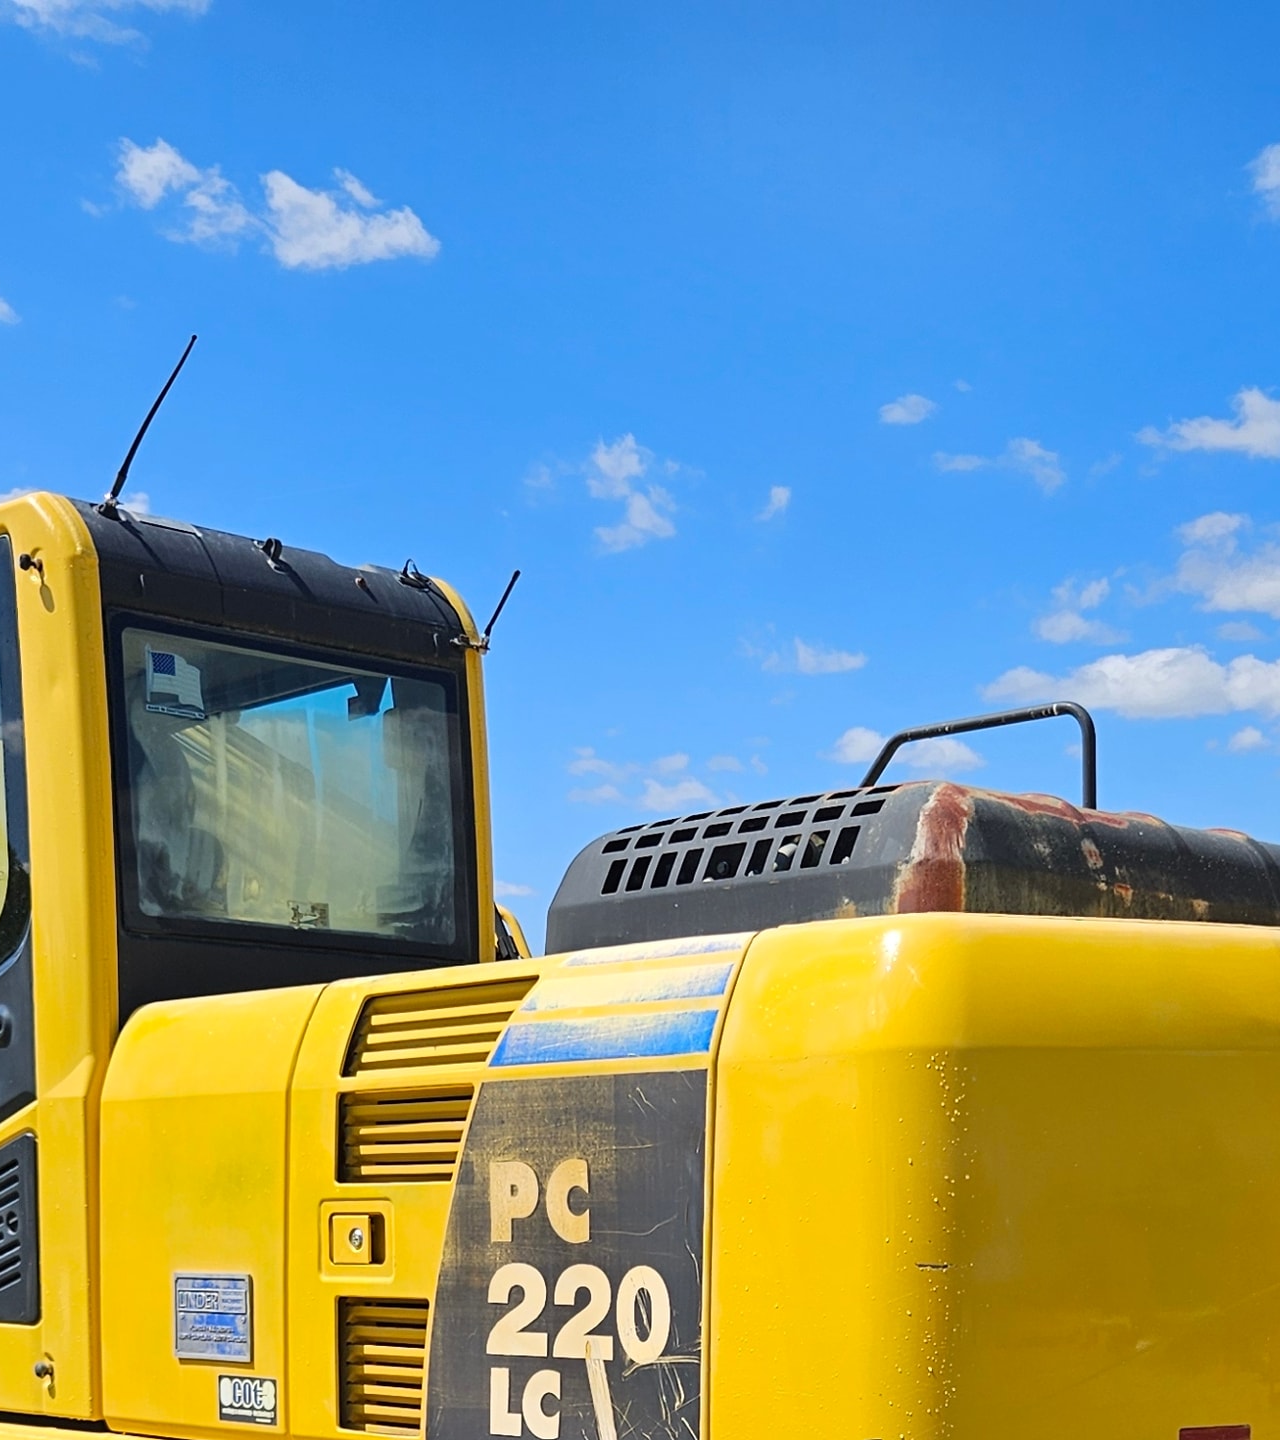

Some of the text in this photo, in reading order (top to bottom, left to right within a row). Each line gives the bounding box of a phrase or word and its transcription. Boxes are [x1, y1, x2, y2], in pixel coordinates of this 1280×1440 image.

[489, 1159, 590, 1243] PC
[486, 1262, 671, 1364] 220
[489, 1366, 561, 1440] LC
